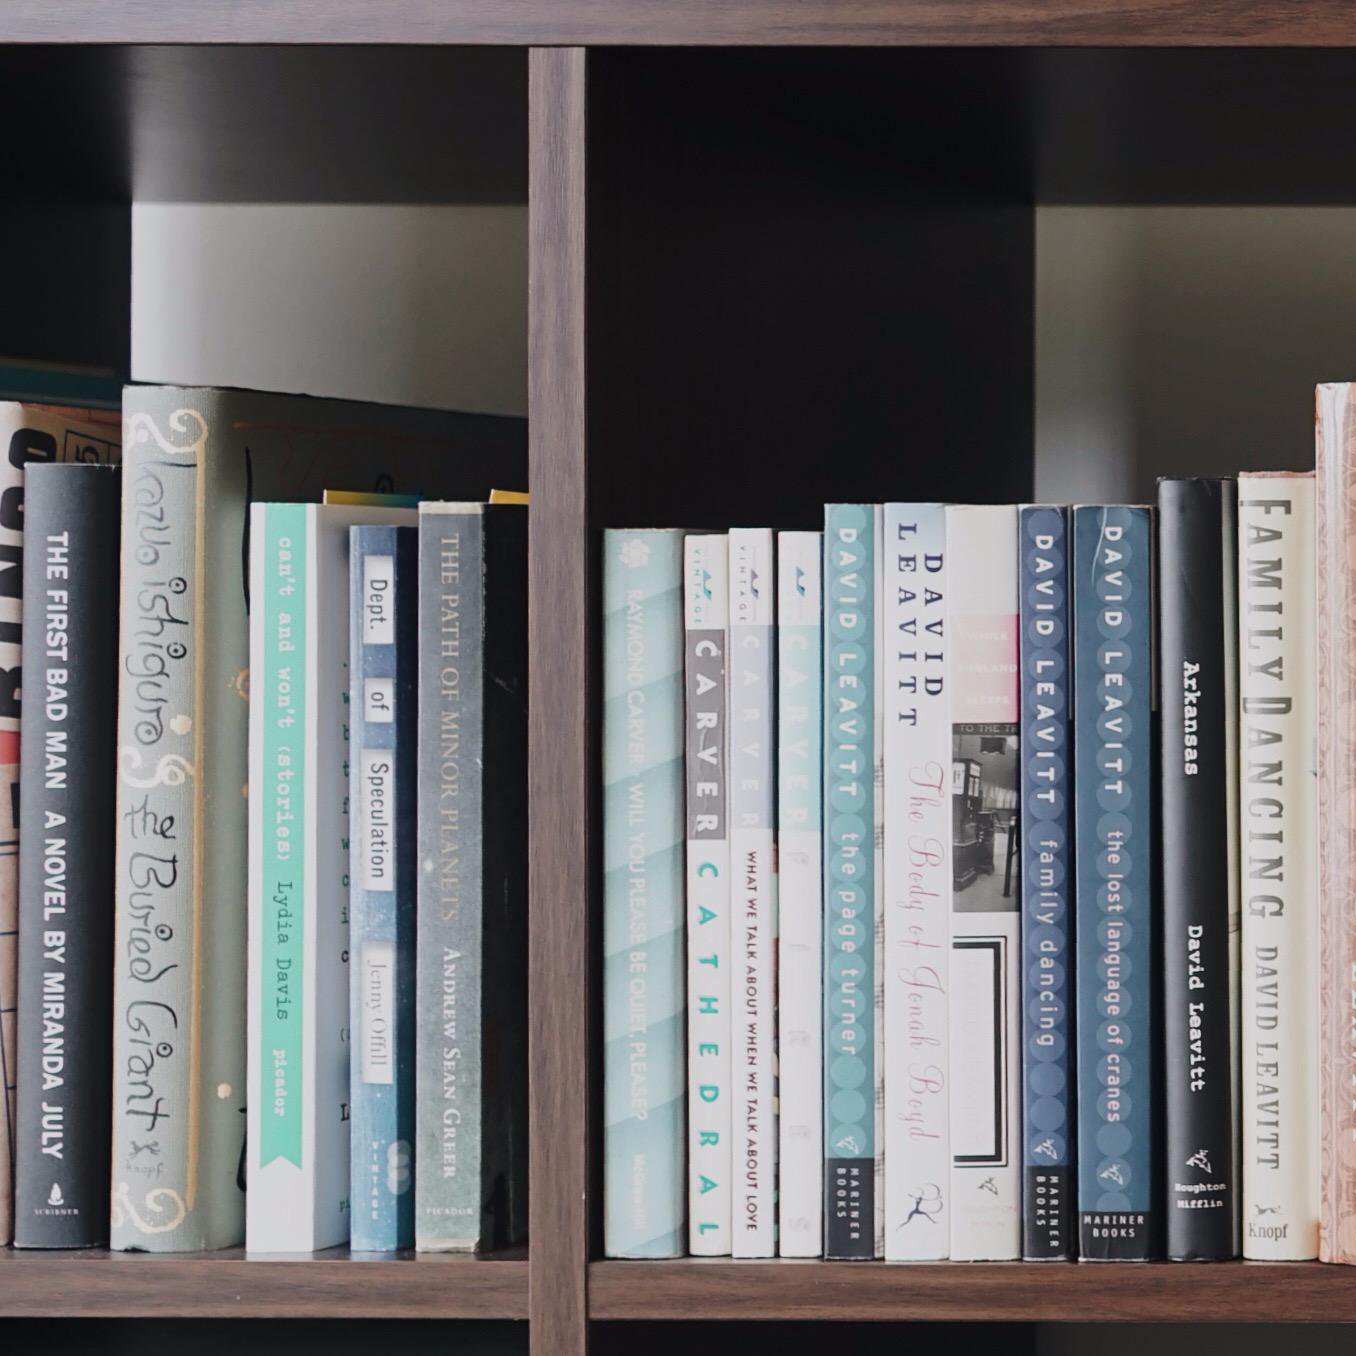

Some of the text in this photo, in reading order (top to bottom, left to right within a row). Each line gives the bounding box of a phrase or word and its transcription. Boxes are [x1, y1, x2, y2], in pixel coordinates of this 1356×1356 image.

[45, 531, 68, 789] THE FIRST BAD MAN
[369, 579, 389, 630] Dept.
[839, 527, 858, 796] DAVID LEAVITT
[897, 522, 918, 726] LEAVITT
[923, 553, 945, 697] DAVID
[1035, 535, 1055, 804] DAVID LEAVITT
[1104, 526, 1123, 794] DAVID LEAVITT
[275, 537, 296, 861] can't and won't (stories)
[371, 692, 390, 710] of
[439, 533, 461, 921] THE PATH OF MINOR PLANETS
[695, 640, 719, 832] CARVER
[1183, 661, 1201, 776] Arkansas
[367, 763, 390, 879] Speculation
[41, 811, 66, 1160] A NOVEL BY MIRANDA JULY
[273, 881, 293, 1021] Lydia Davis
[366, 961, 388, 1066] Jenny Offill
[838, 833, 859, 1055] the page turner
[1036, 841, 1059, 1046] family dancing
[1104, 832, 1124, 1123] the lost language of cranes
[1187, 925, 1206, 1092] David Leavitt
[127, 1001, 178, 1131] Giant
[272, 1048, 289, 1117] picador
[443, 947, 462, 1179] ANDREW SEAN GREER
[697, 862, 720, 1236] CATHEDRAL
[746, 851, 758, 1231] WHAT TALK ABOUT WHEN WE TALK ABOUT LOVE
[1254, 946, 1280, 1170] DAVID LEAVITT
[425, 1207, 473, 1215] PICADOR
[836, 1168, 847, 1218] BOOKS
[849, 1168, 860, 1240] MARINER
[1036, 1175, 1046, 1226] BOOKS
[1049, 1175, 1059, 1247] MARINER
[1083, 1214, 1145, 1225] MARINER
[1093, 1227, 1136, 1238] BOOKS
[1174, 1183, 1227, 1194] Houghton
[1177, 1199, 1224, 1210] Mifflin
[1248, 1222, 1289, 1241] Knopf
